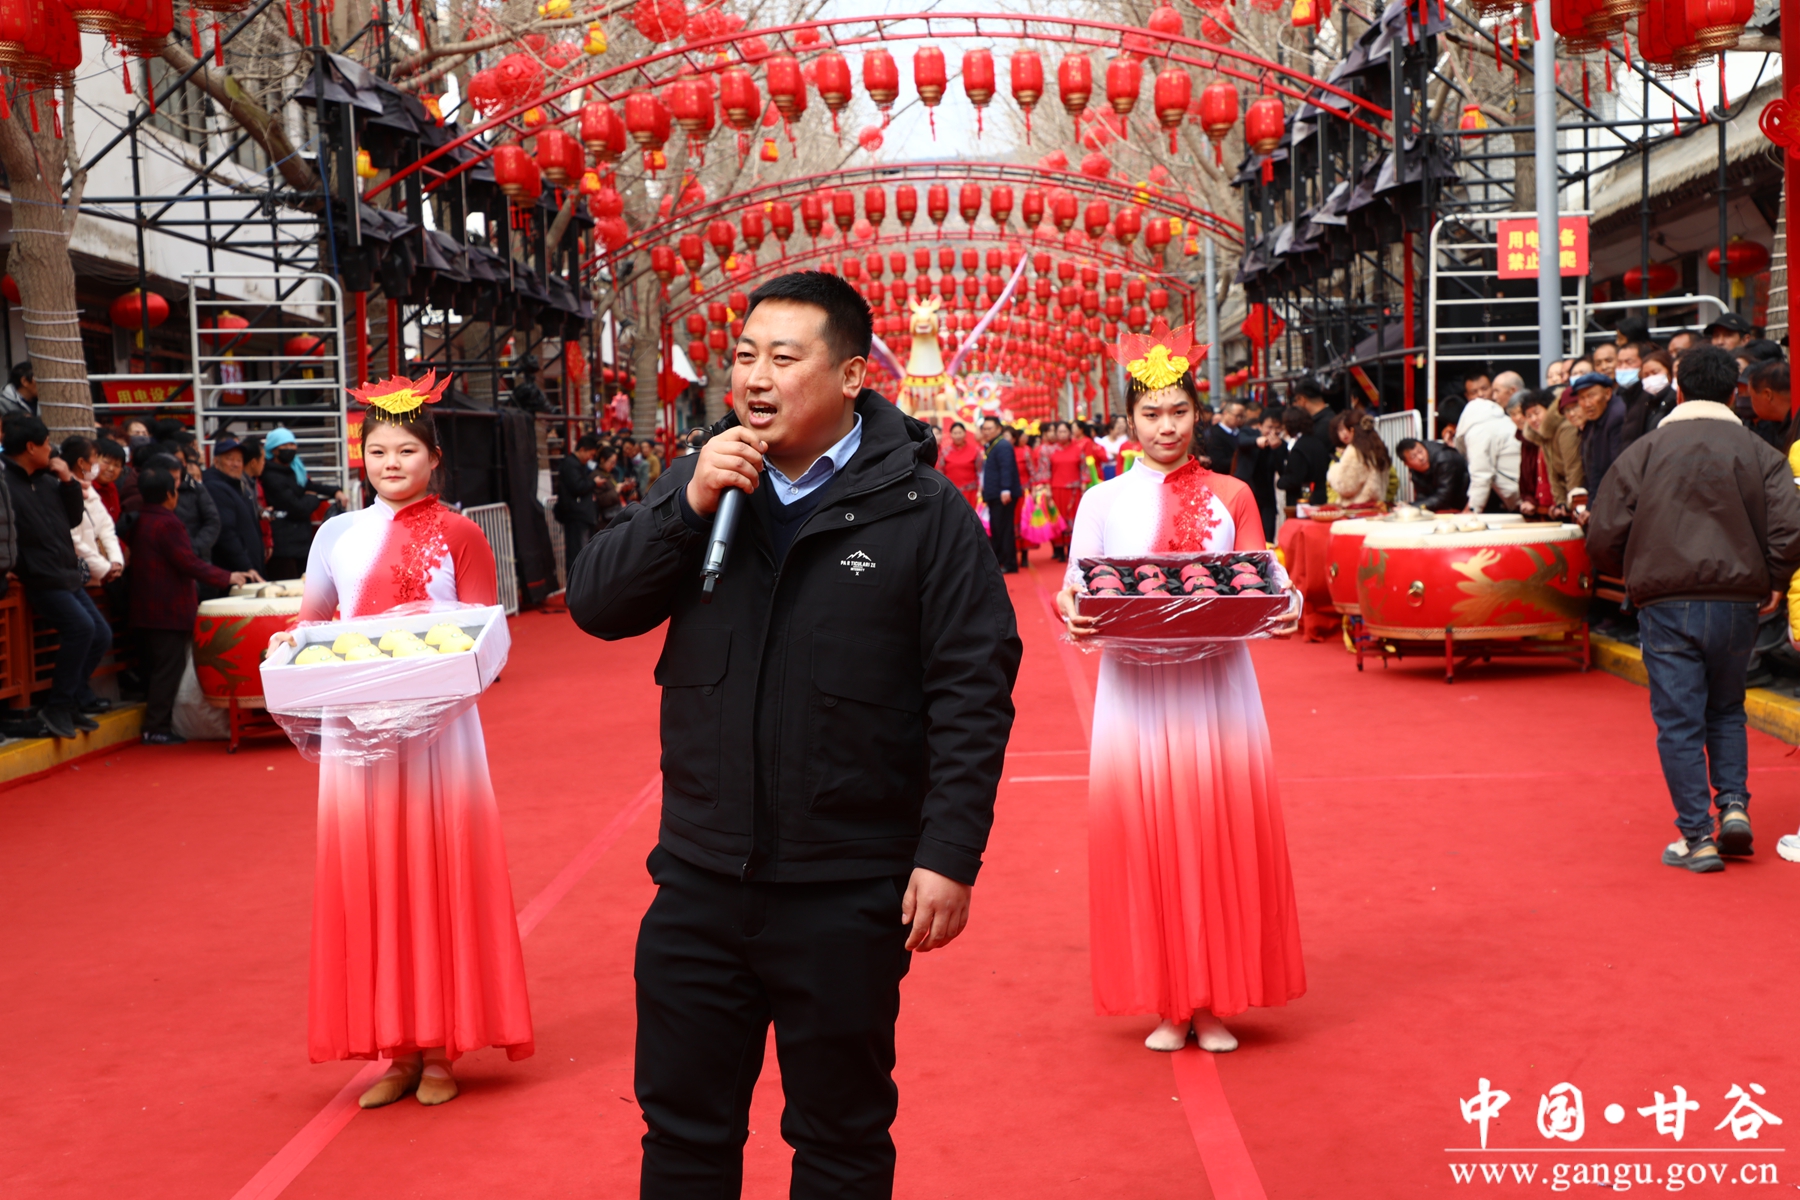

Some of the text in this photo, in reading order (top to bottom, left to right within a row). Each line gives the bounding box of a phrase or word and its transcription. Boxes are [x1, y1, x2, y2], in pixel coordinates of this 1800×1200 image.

[1508, 228, 1576, 250] 用电备
[1508, 250, 1577, 271] 禁止爬
